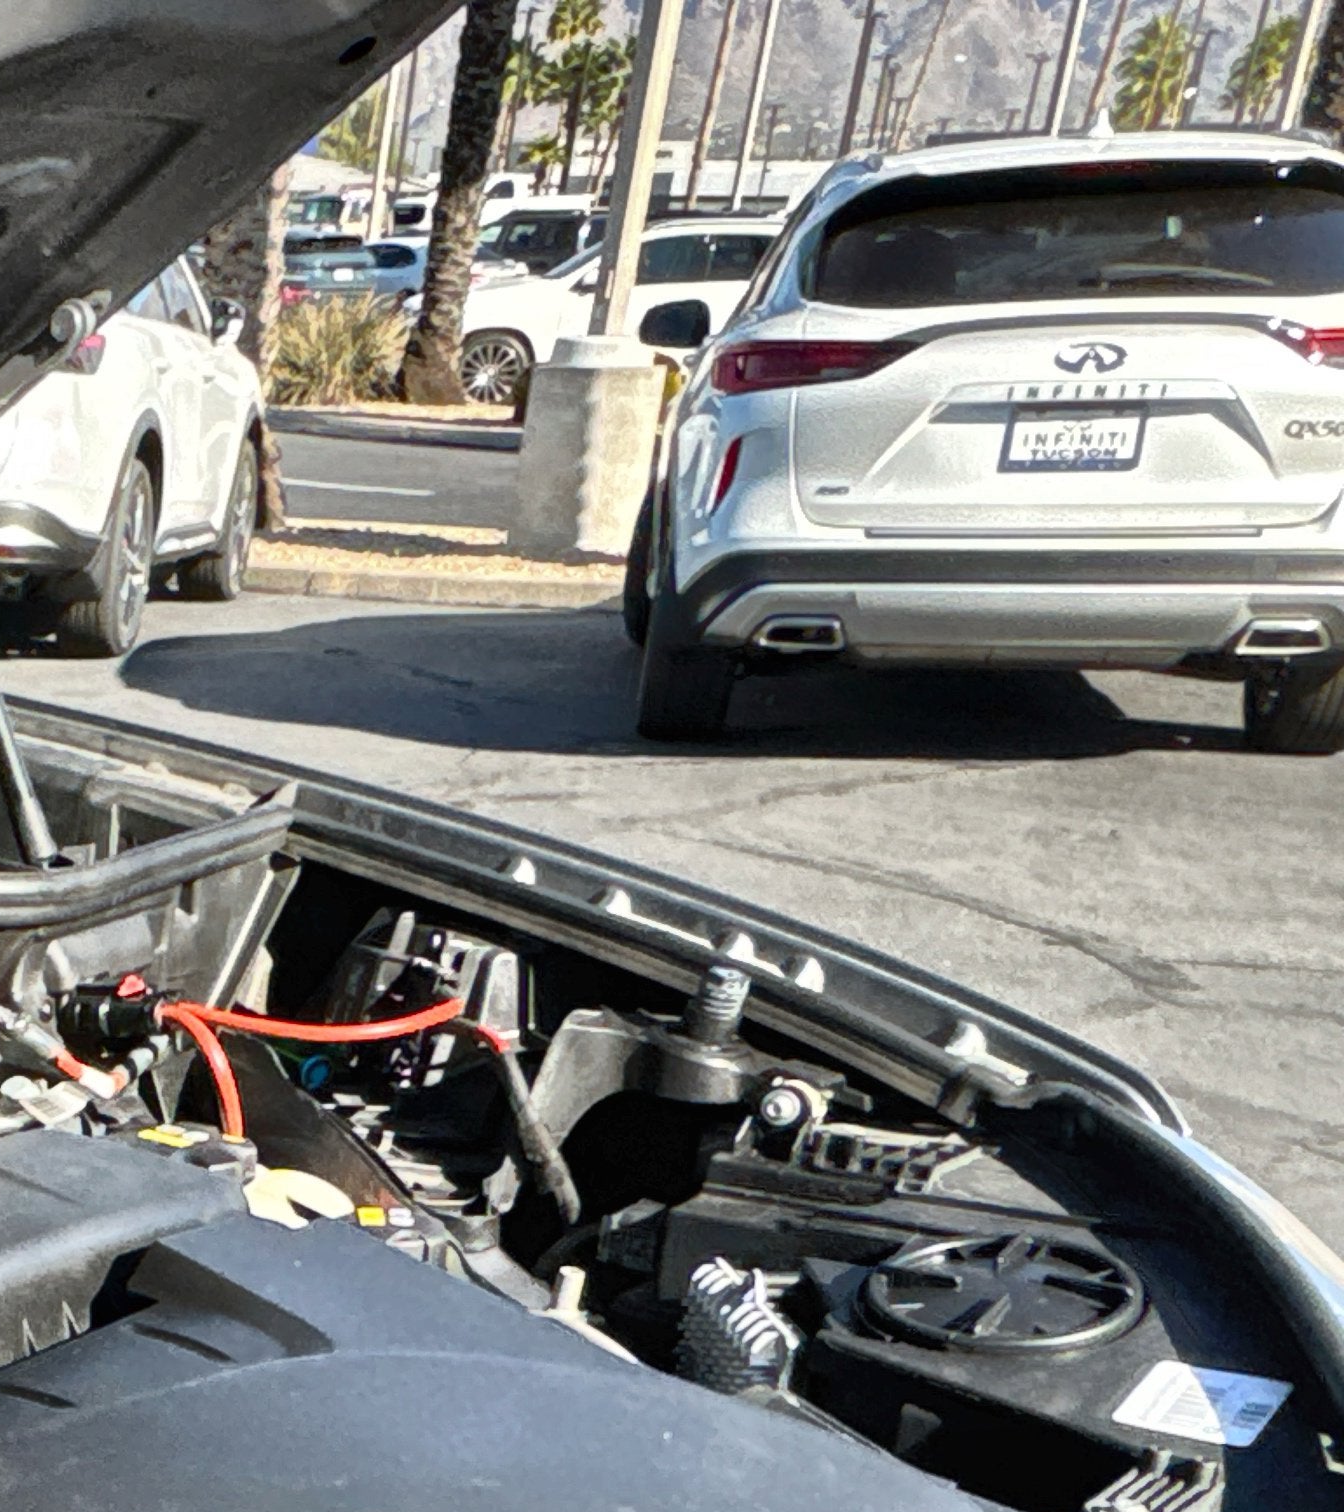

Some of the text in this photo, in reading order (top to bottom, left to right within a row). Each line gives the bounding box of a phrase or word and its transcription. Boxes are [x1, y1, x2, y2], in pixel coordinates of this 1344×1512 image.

[1007, 383, 1169, 400] INFINITI
[1023, 431, 1128, 447] INFINITI
[1030, 448, 1119, 460] TUCSON
